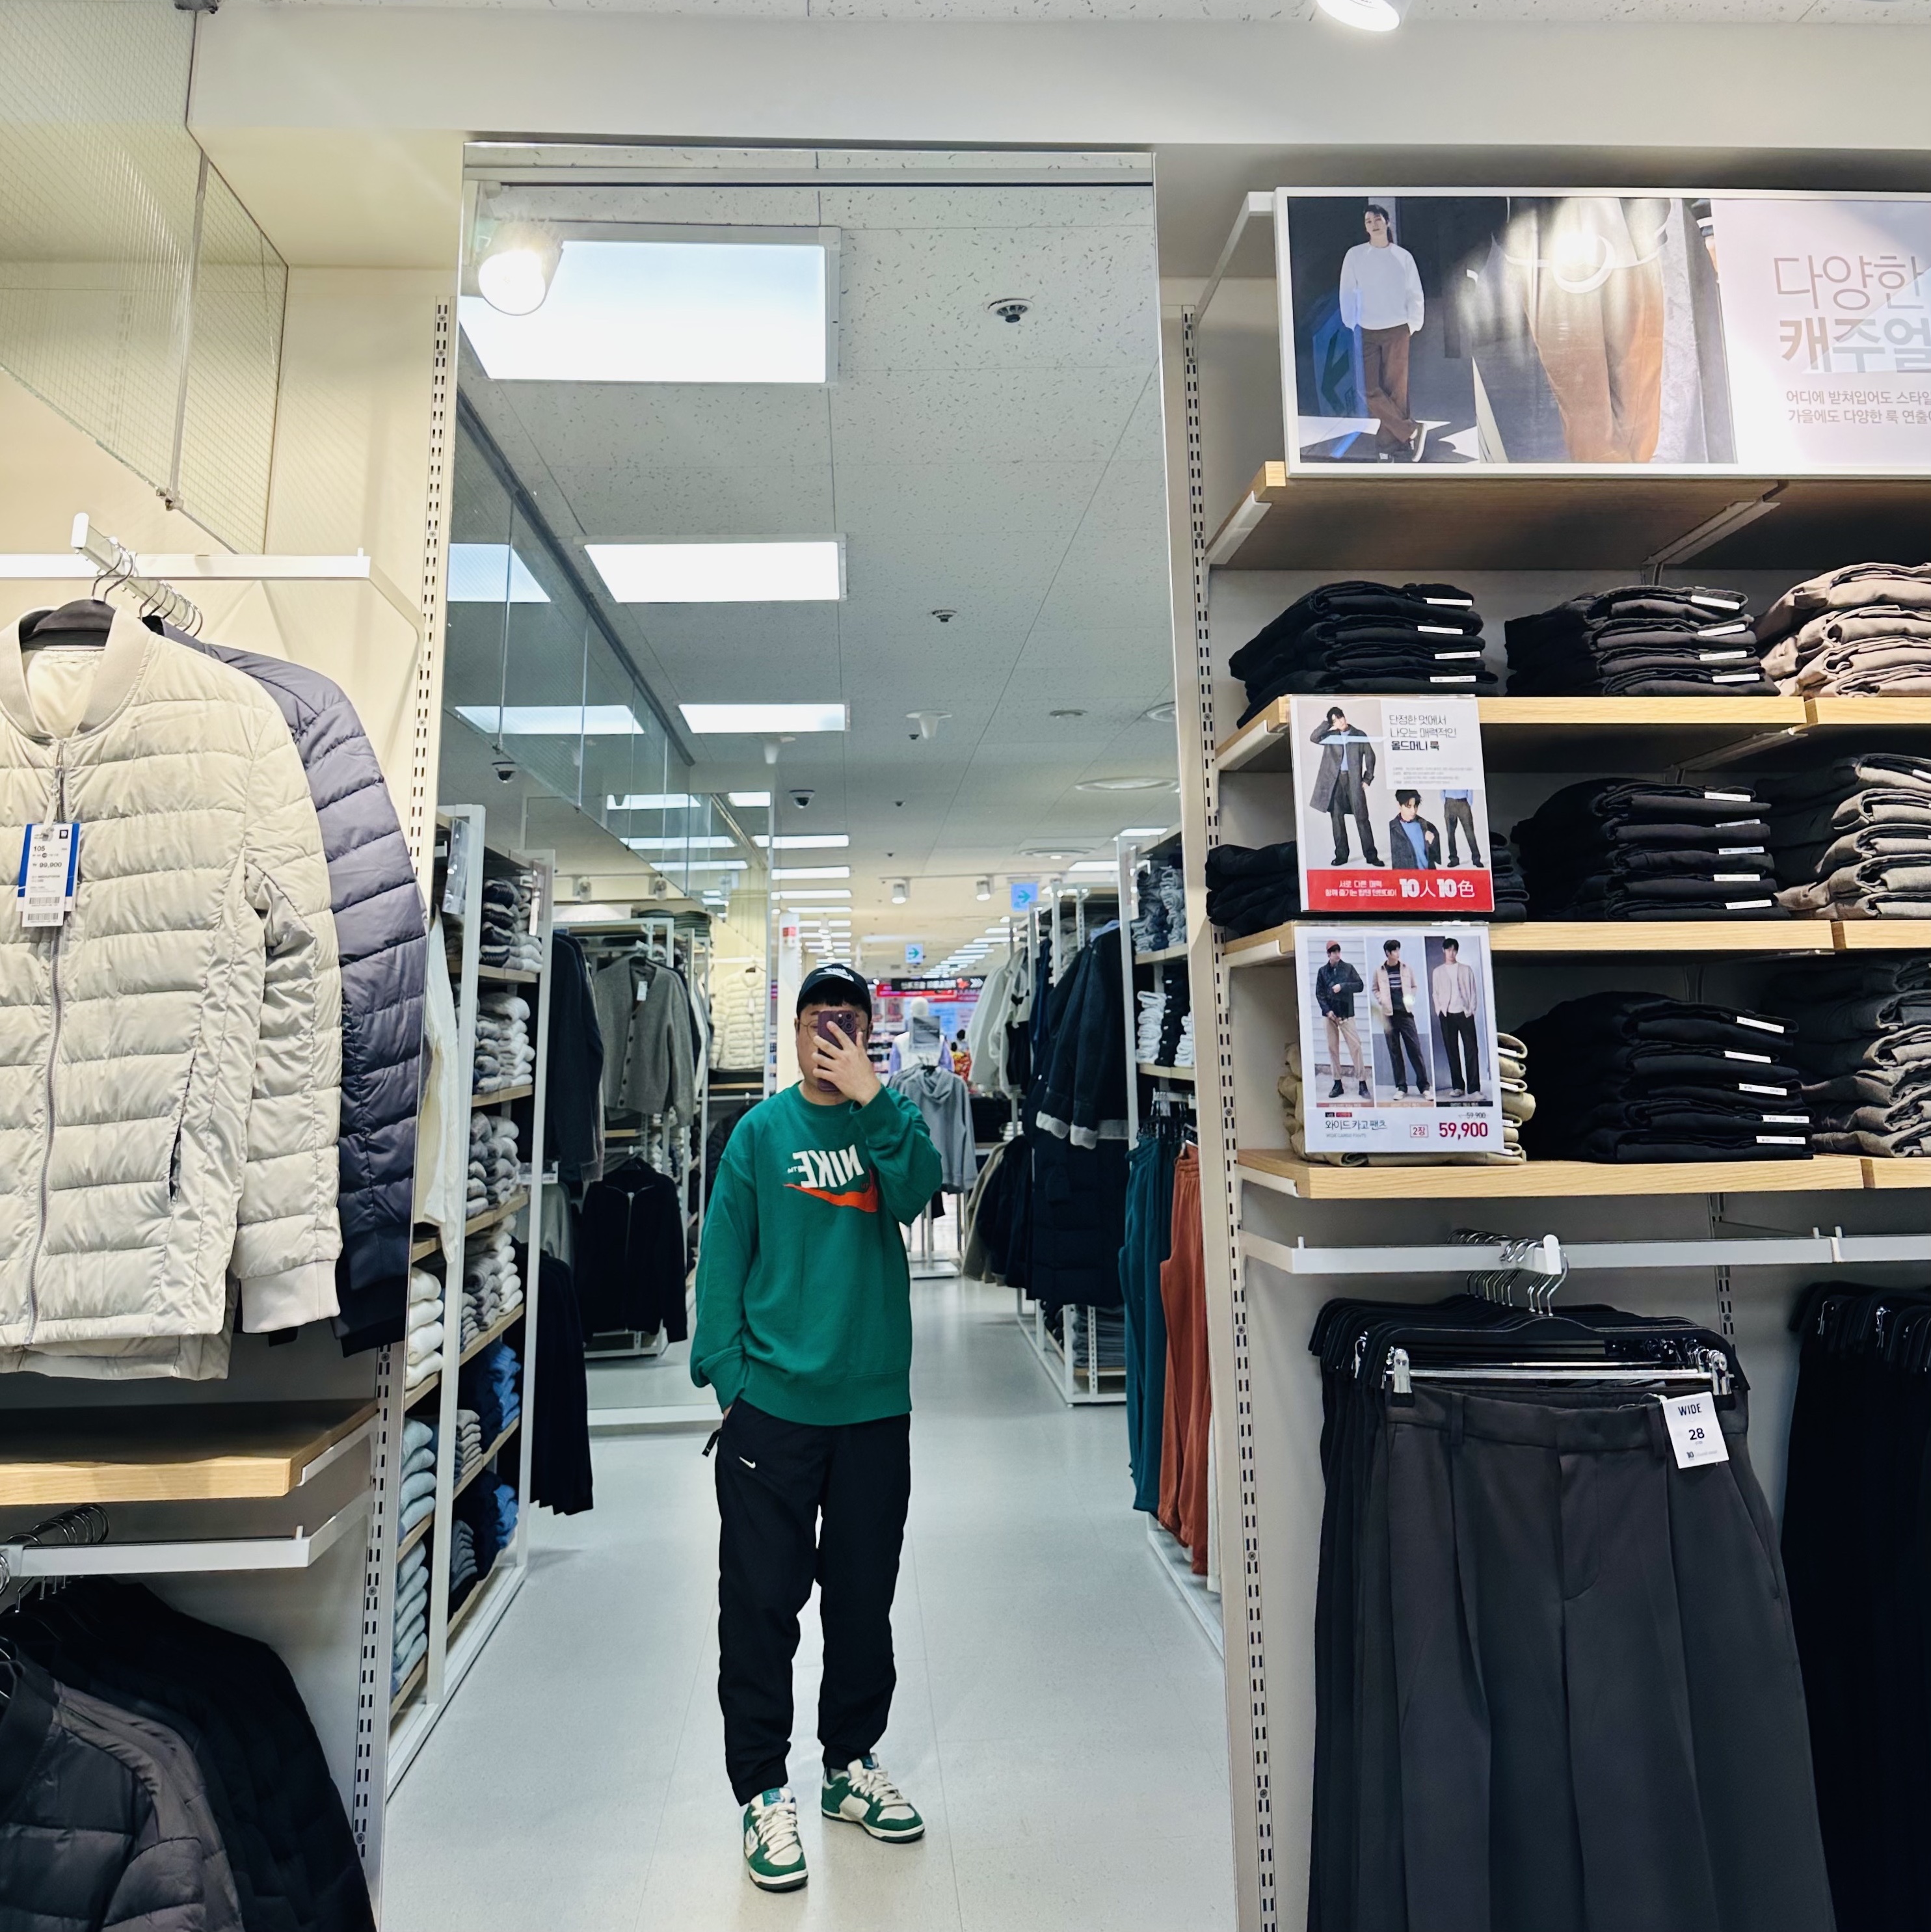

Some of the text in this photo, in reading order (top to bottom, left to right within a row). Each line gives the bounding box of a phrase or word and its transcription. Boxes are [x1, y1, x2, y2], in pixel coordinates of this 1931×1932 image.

[1774, 254, 1924, 311] 다양한
[1779, 317, 1931, 373] 캐주얼
[1786, 390, 1824, 405] 어디에
[1828, 390, 1893, 405] 받쳐입어도
[1788, 409, 1840, 423] 가을에도
[1843, 409, 1882, 424] 다양한
[1885, 410, 1898, 424] 룩
[1389, 714, 1446, 725] 단정한 멋에서
[1390, 727, 1457, 738] 나오는 매력적인
[1391, 740, 1428, 751] 올드머니
[1413, 1127, 1426, 1136] 2장
[1439, 1122, 1488, 1140] 59,900
[1678, 1403, 1702, 1416] WIDE
[1688, 1428, 1705, 1440] 28
